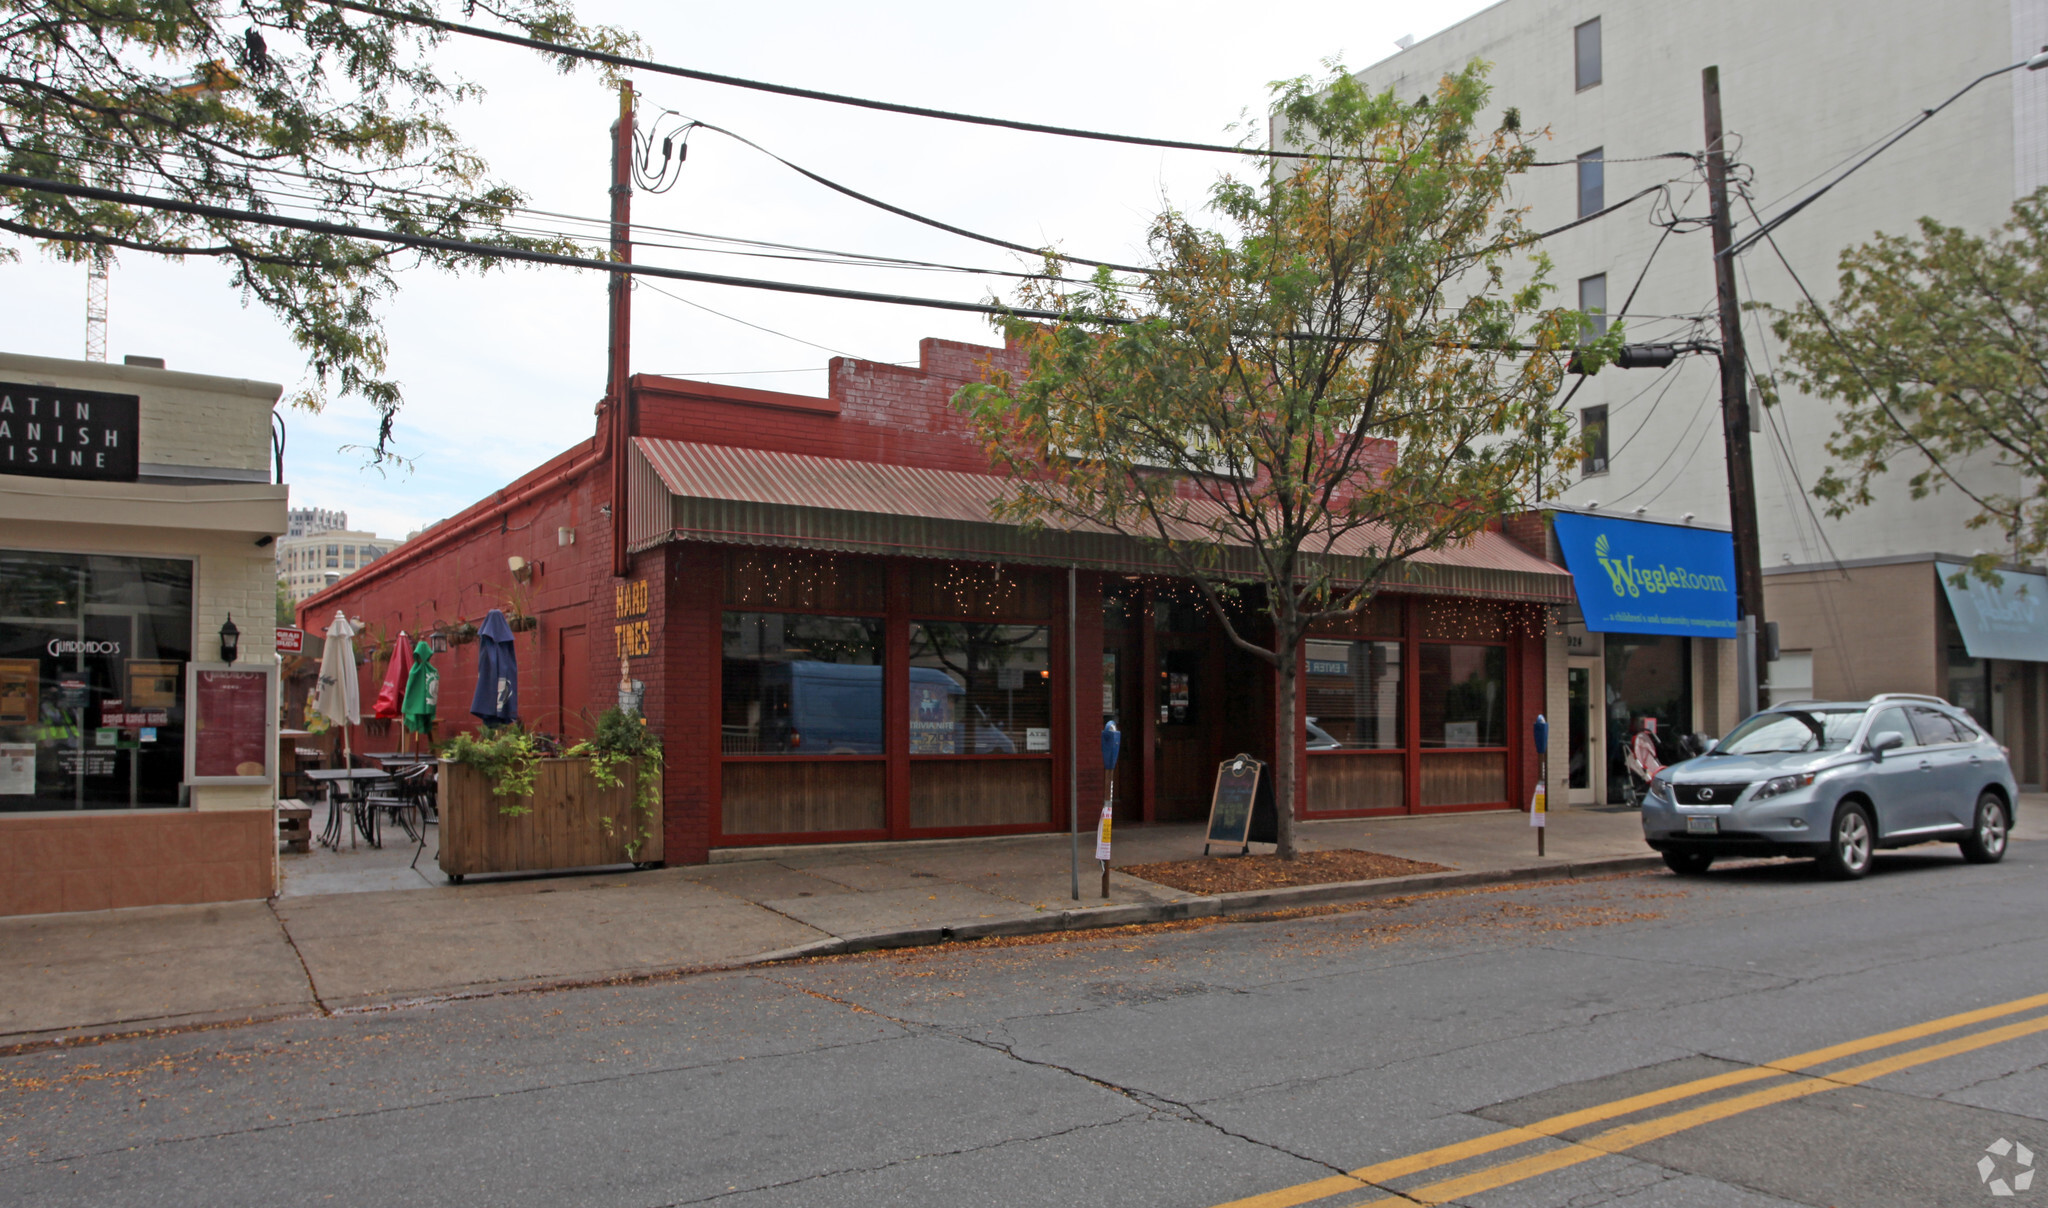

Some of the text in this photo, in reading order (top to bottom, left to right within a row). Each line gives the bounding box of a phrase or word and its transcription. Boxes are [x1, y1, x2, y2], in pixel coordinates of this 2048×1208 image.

[616, 579, 648, 619] HARD
[277, 631, 300, 640] GRAB
[615, 620, 650, 658] TIMES
[47, 638, 121, 658] GUARDADO'S
[910, 721, 954, 731] TRIVIA NITE
